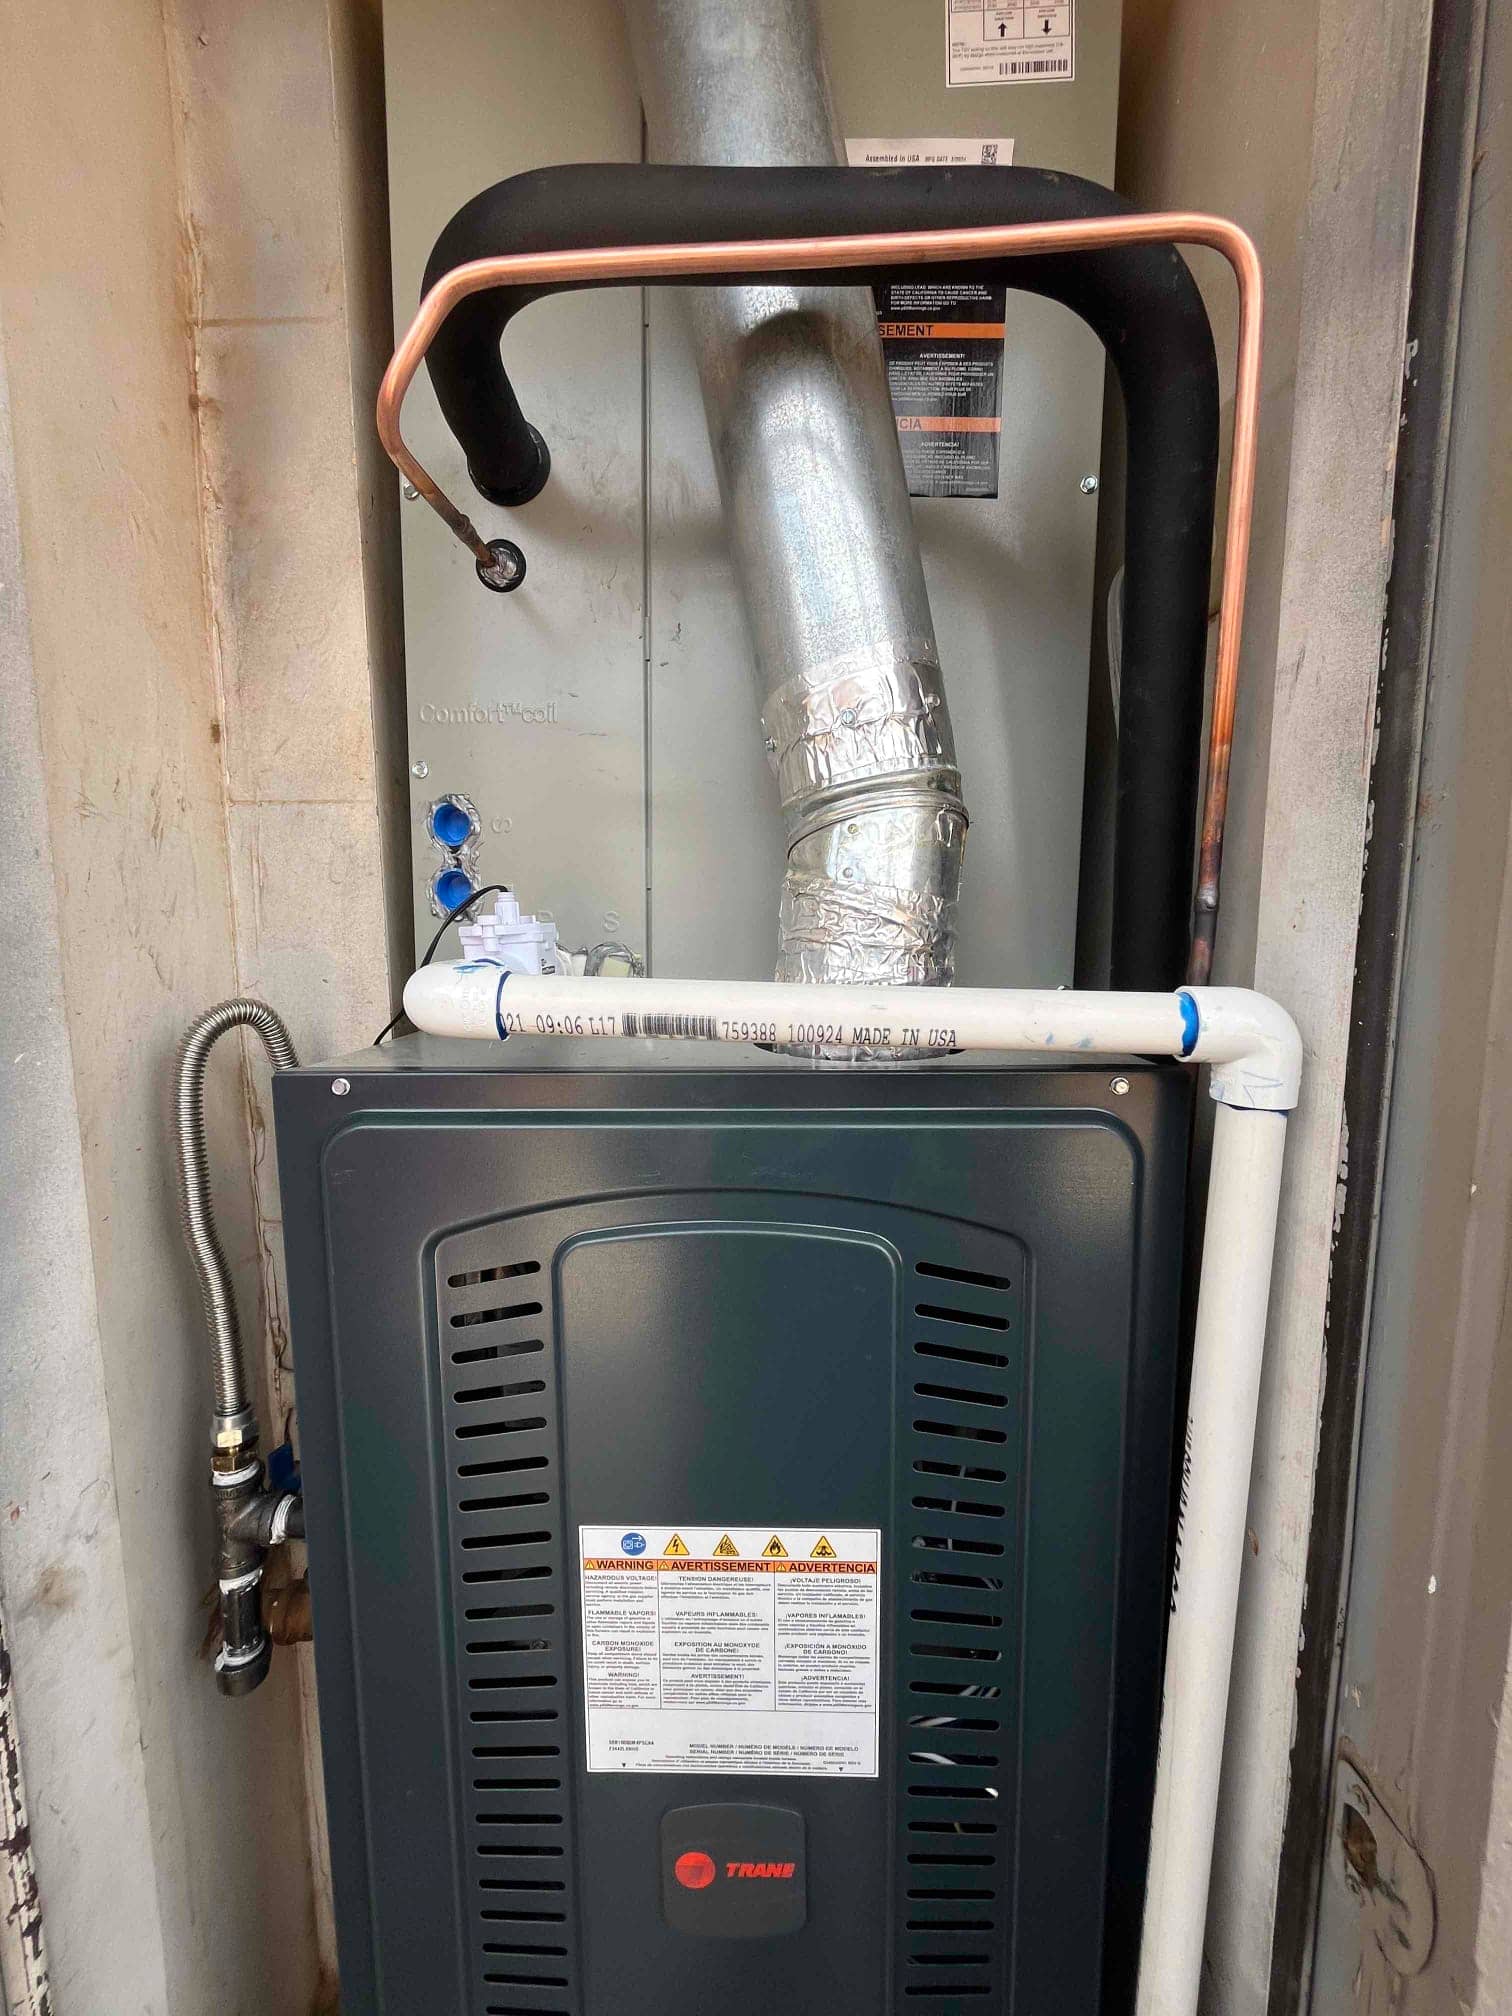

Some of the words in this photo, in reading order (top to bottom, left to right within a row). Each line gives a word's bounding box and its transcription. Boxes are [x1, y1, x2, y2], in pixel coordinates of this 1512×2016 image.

[907, 153, 920, 162] USA
[535, 1014, 584, 1035] 09:06
[721, 1021, 777, 1042] 759388
[787, 1023, 843, 1044] 100924
[852, 1026, 891, 1046] MADE
[901, 1028, 920, 1046] IN
[927, 1029, 957, 1048] USA
[596, 1560, 654, 1570] WARNING
[671, 1561, 770, 1571] AVERTISSEMENT
[789, 1563, 876, 1573] ADVERTENCIA
